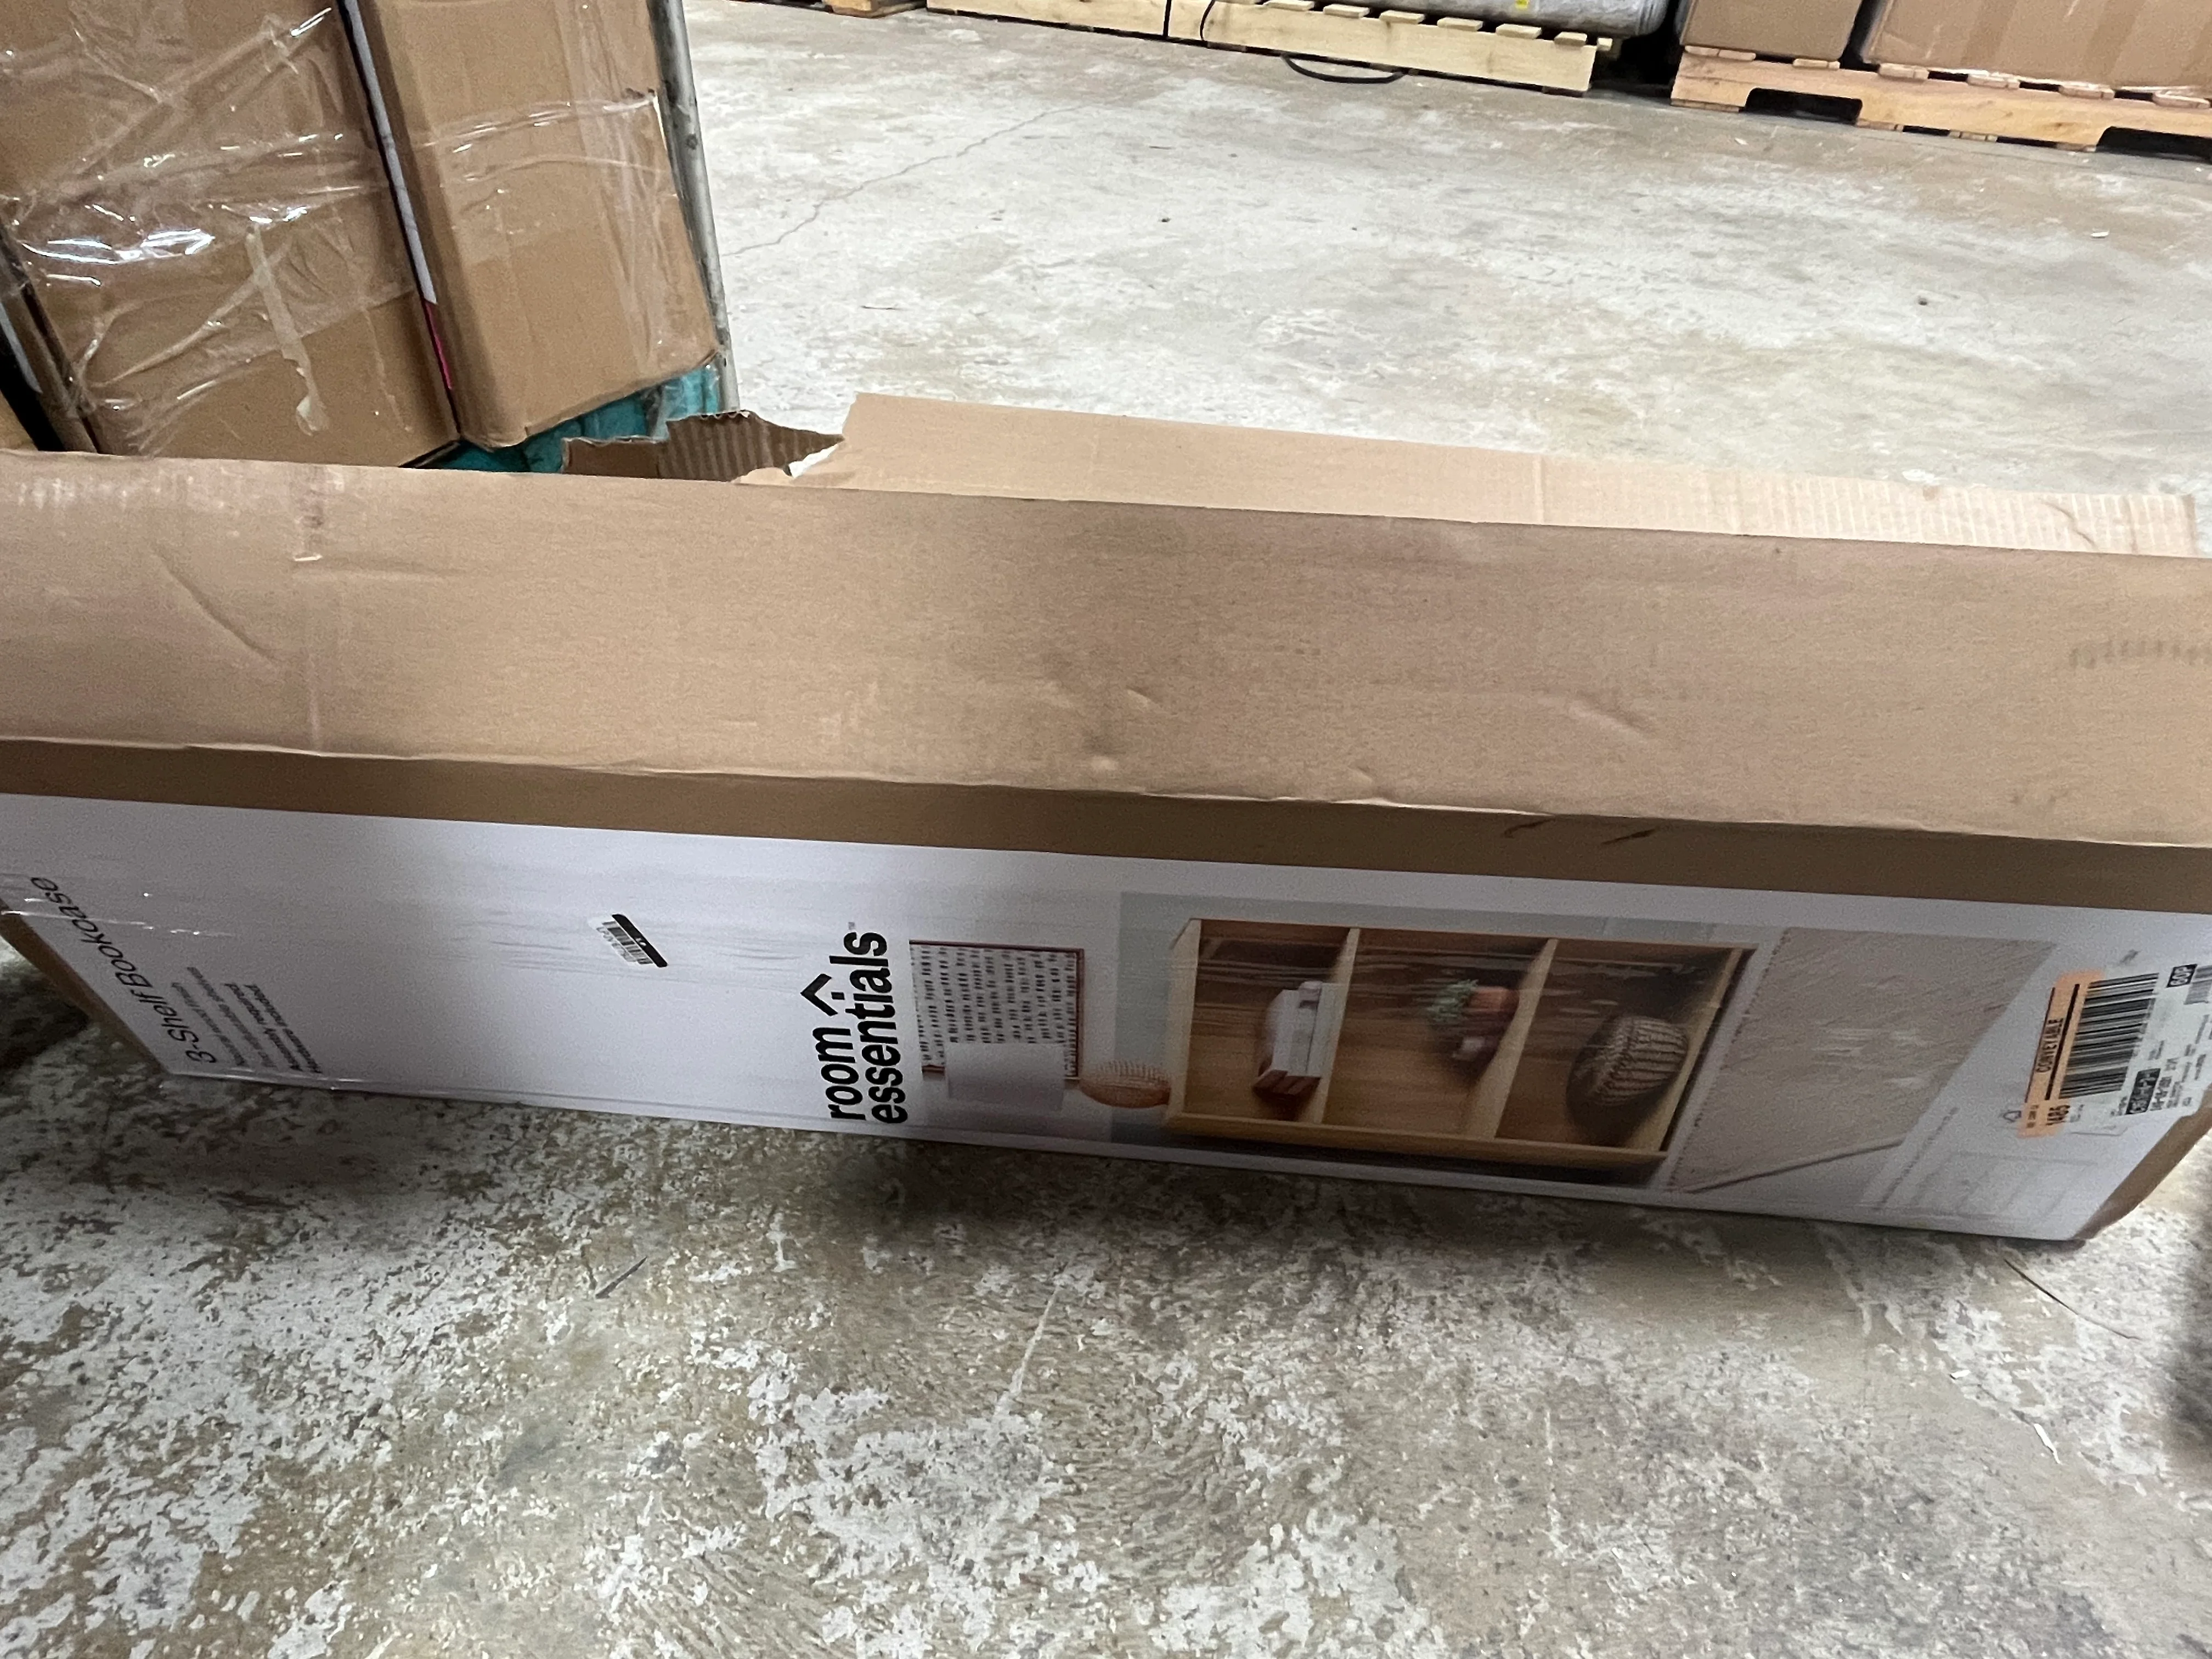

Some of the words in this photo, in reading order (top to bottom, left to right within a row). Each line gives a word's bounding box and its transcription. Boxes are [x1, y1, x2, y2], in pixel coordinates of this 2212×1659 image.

[31, 877, 153, 989] Bookcase
[132, 989, 217, 1063] 3-Shelf
[812, 1026, 867, 1121] room
[829, 932, 908, 1124] essentials
